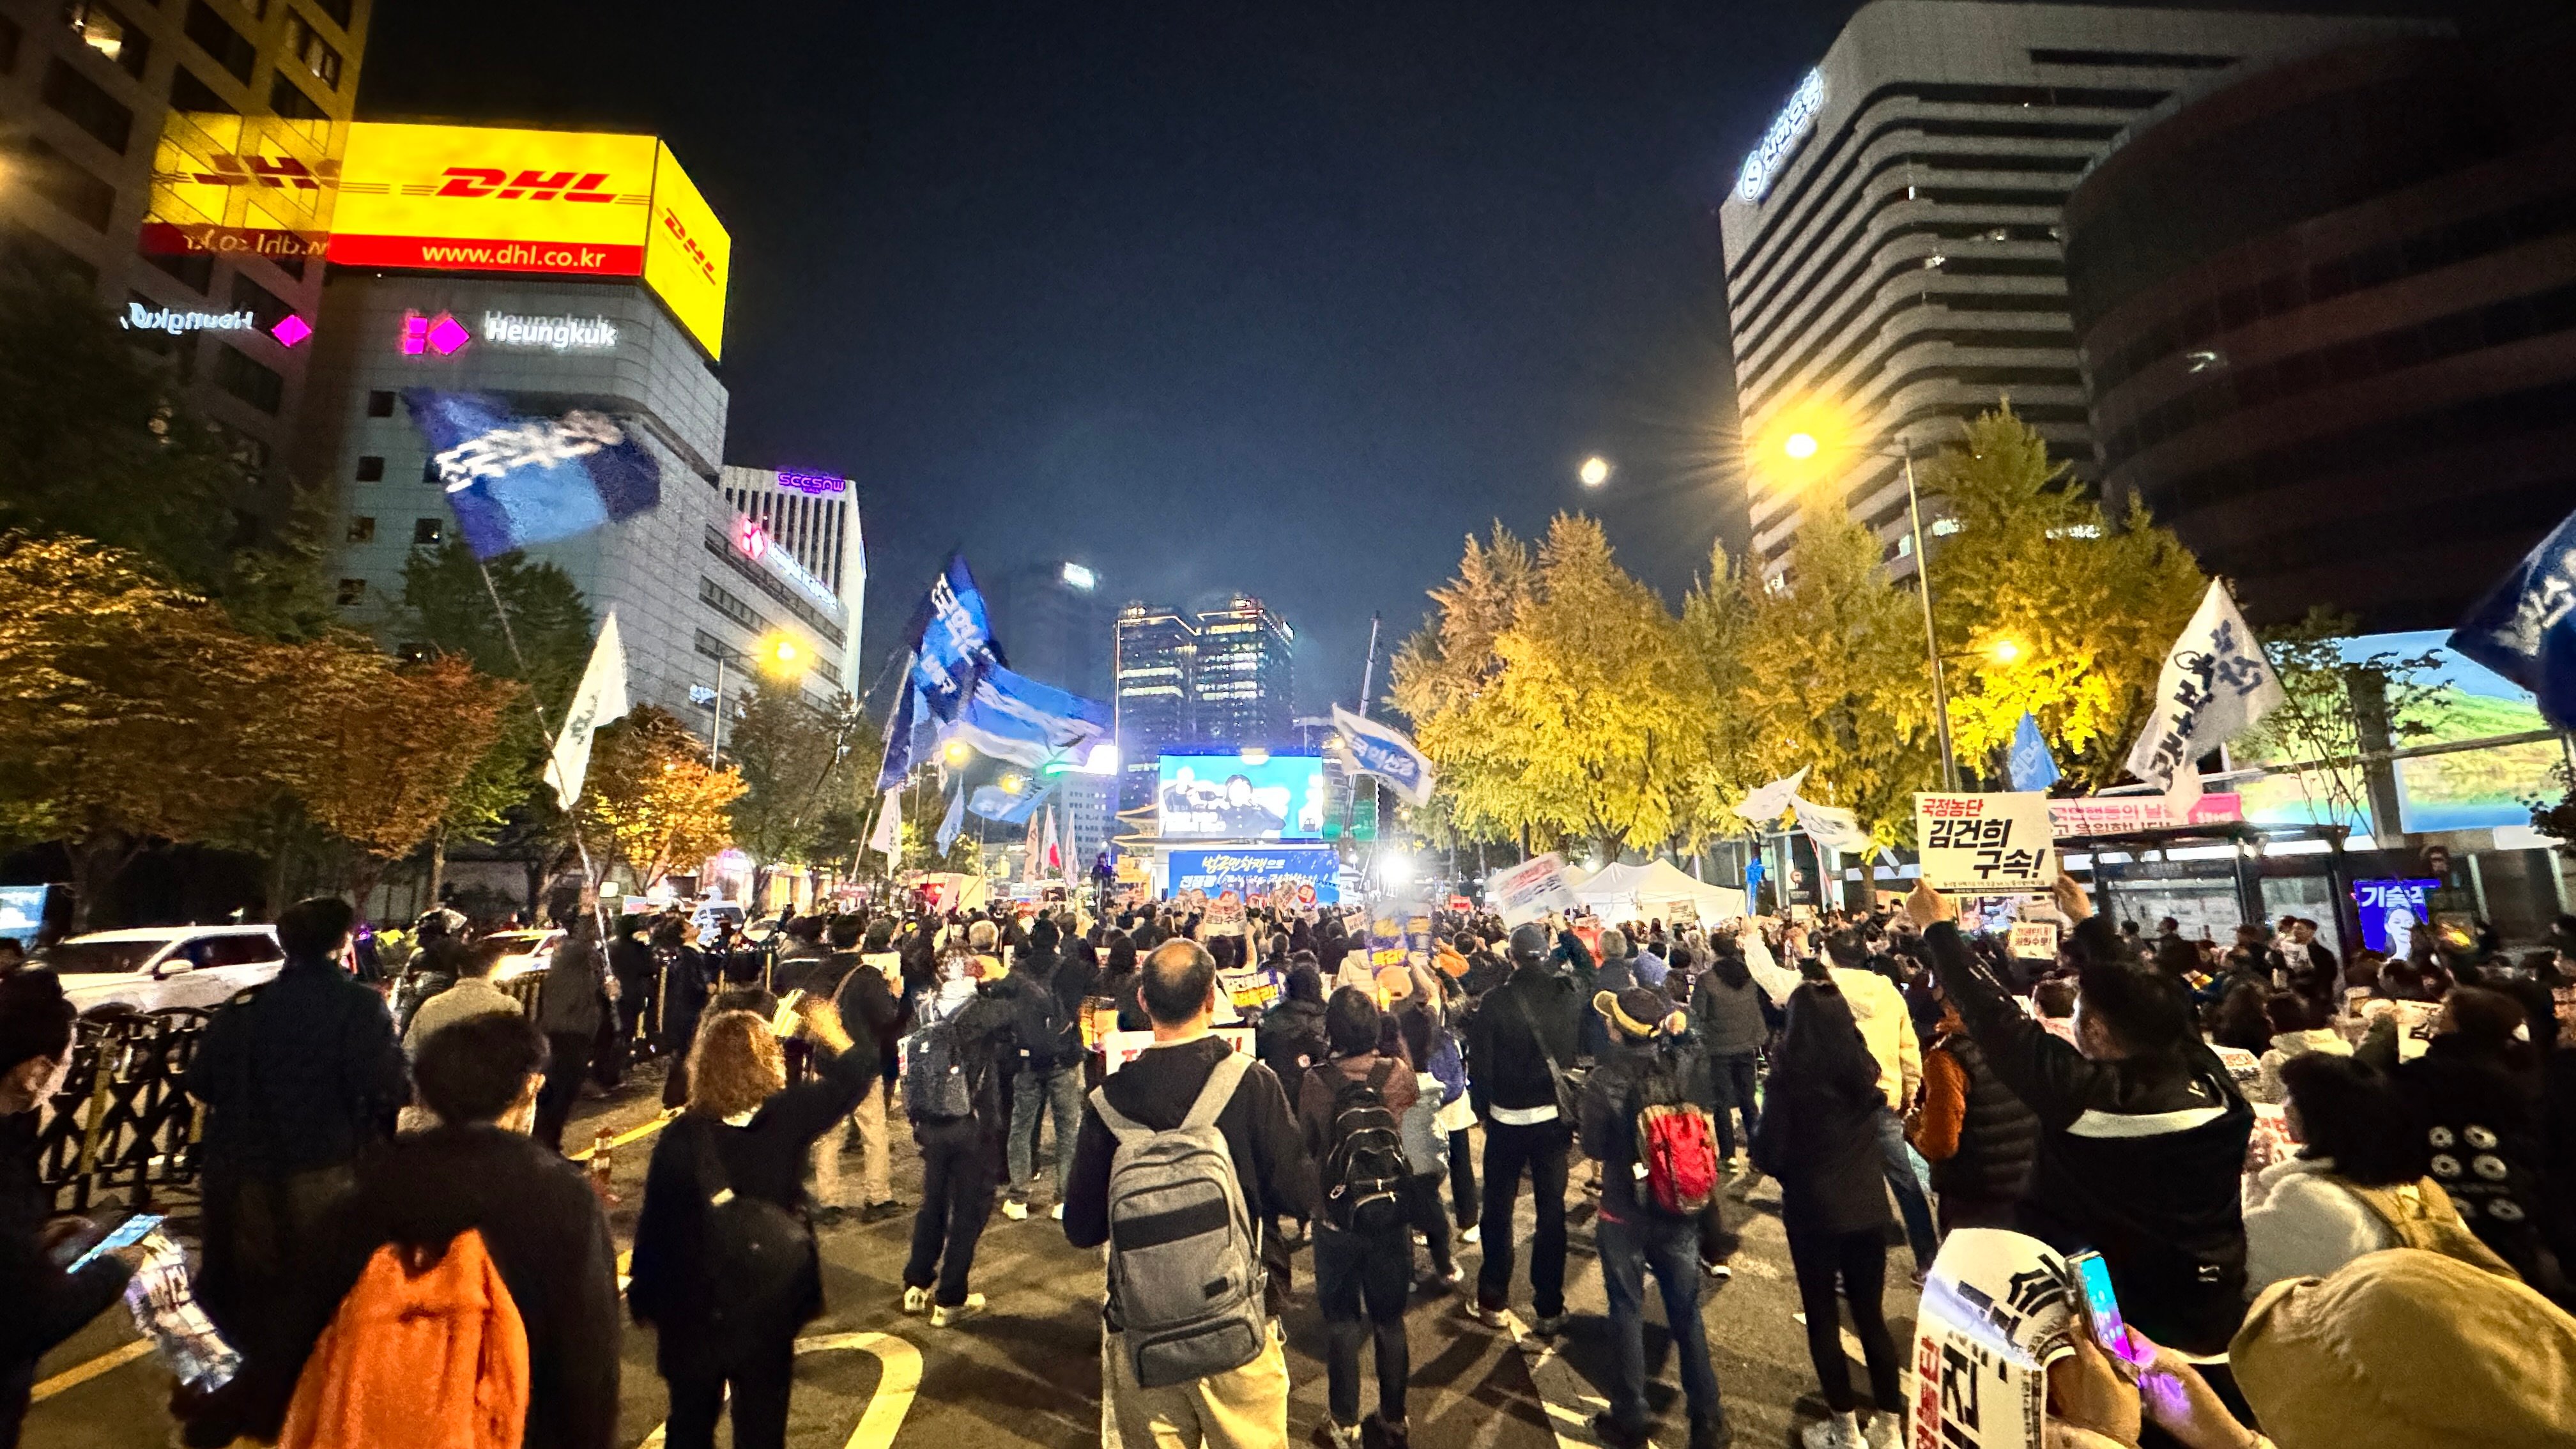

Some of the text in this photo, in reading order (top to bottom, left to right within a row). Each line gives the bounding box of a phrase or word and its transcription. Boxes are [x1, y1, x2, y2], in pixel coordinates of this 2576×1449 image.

[434, 167, 618, 203] DHL
[422, 244, 606, 268] www.dhl.co.kr
[664, 207, 716, 286] DHL
[488, 319, 615, 349] Heungkuk
[1922, 799, 1984, 817] 국정농단
[1928, 819, 2012, 848] 김건희
[1973, 848, 2046, 880] 구속!
